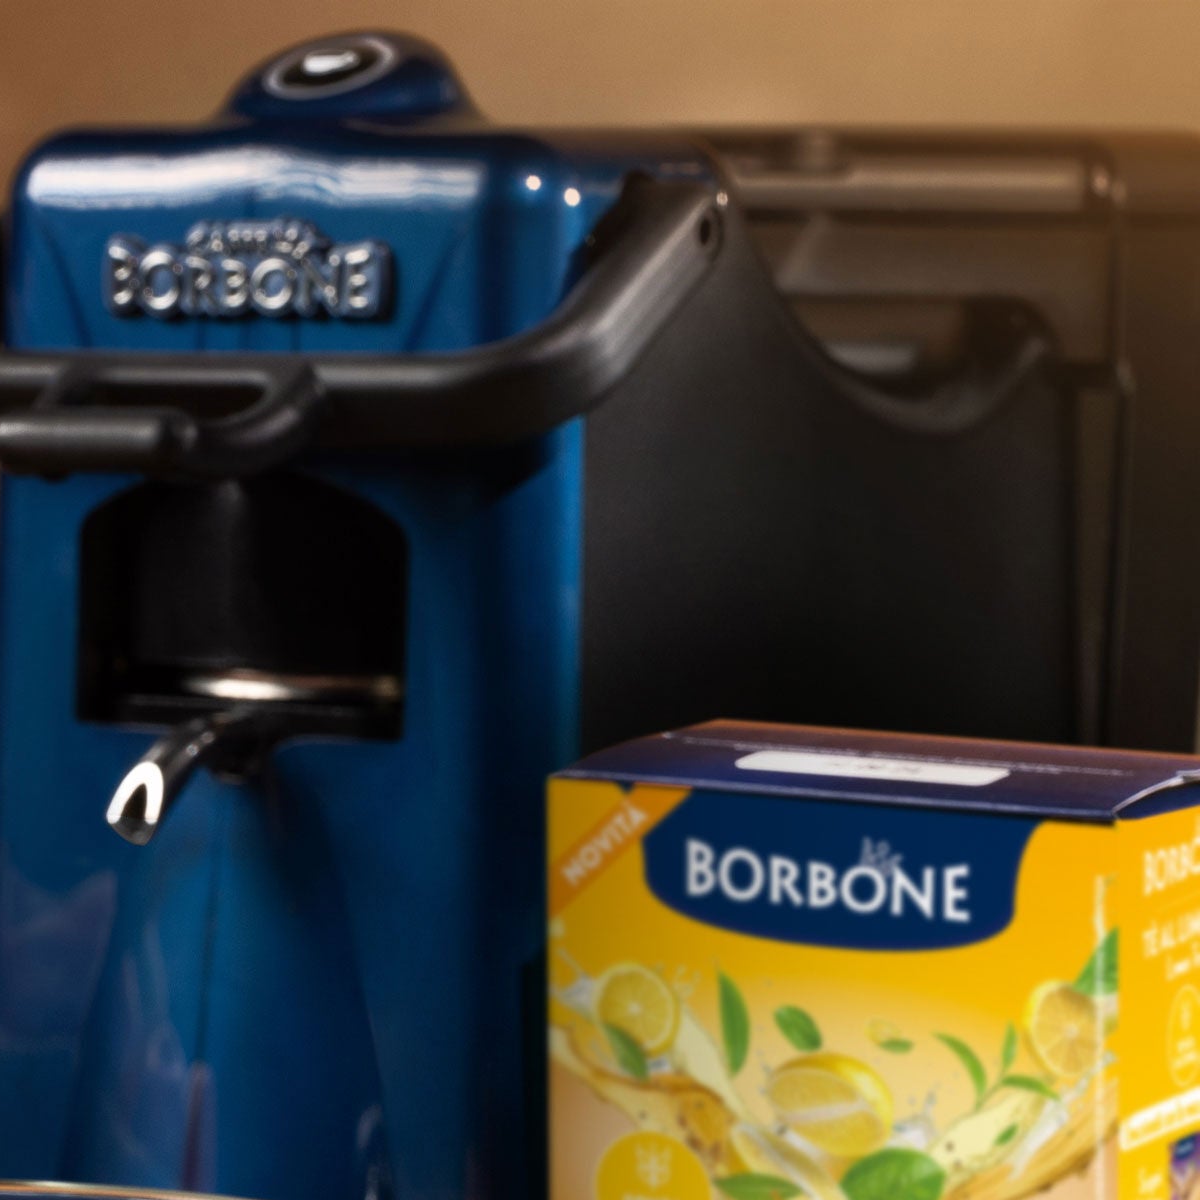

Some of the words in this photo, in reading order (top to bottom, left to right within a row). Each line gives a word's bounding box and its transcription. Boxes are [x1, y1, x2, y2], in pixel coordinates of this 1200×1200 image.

[108, 238, 384, 314] BORBONE
[563, 801, 647, 886] NOVITÀ
[686, 837, 971, 922] BORBONE
